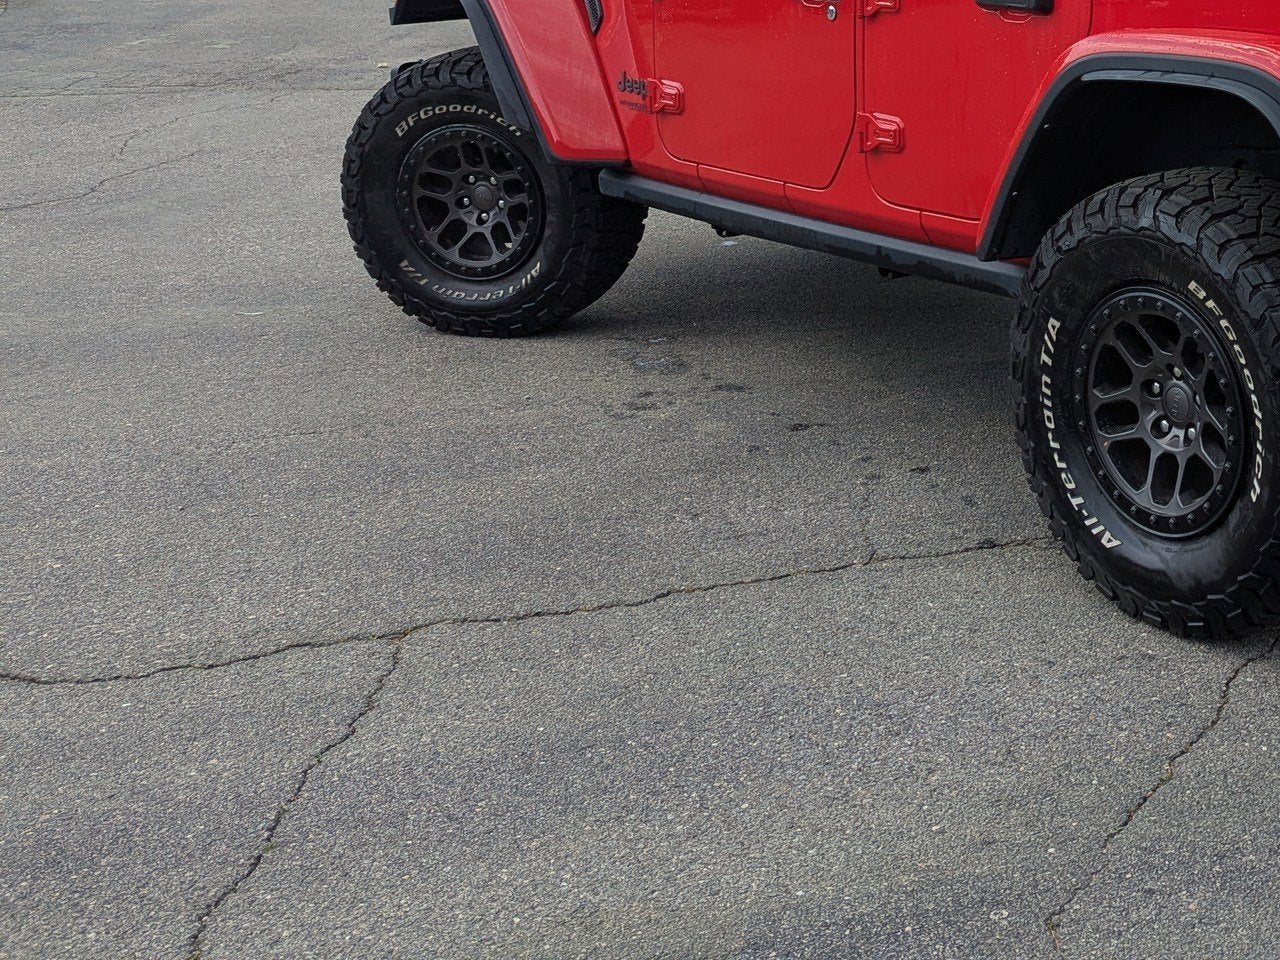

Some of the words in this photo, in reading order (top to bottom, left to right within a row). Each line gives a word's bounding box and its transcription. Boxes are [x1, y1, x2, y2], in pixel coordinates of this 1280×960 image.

[617, 70, 648, 101] Jeep
[394, 103, 522, 138] BFGoodrich
[399, 259, 431, 286] T/A
[431, 261, 541, 302] All-Terrain
[1040, 316, 1061, 367] T/A
[1187, 280, 1265, 503] BFGoodrich
[1039, 374, 1123, 549] All-Terrain
